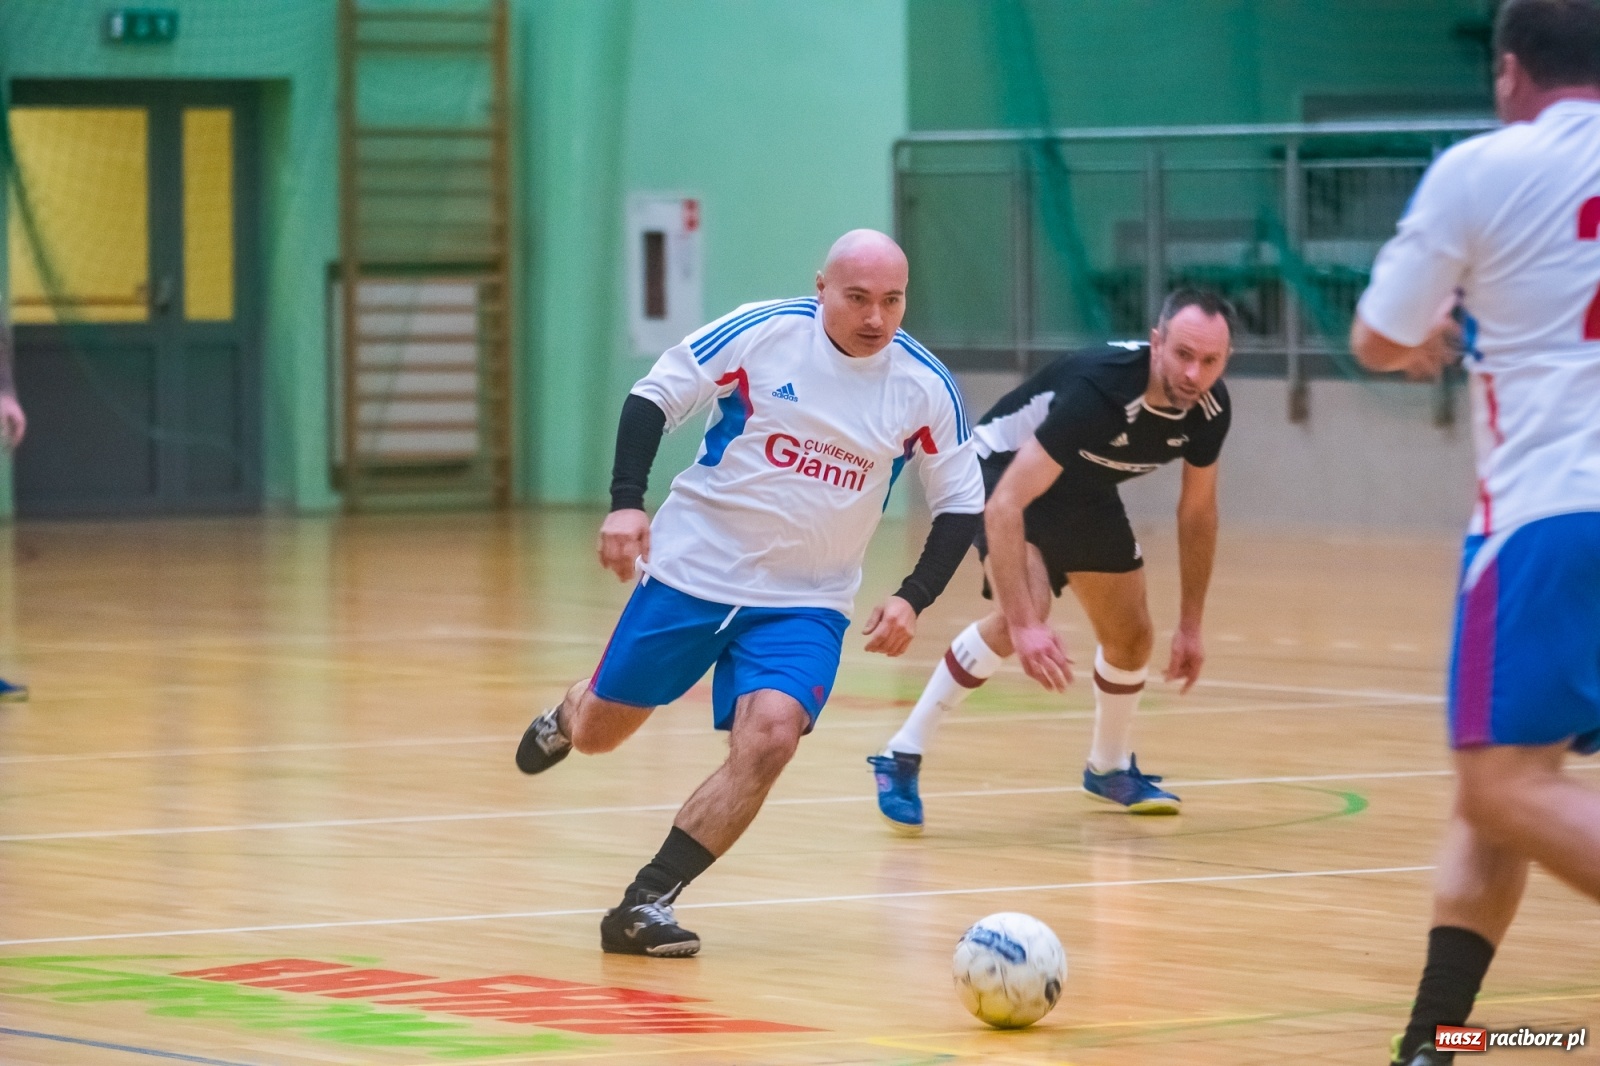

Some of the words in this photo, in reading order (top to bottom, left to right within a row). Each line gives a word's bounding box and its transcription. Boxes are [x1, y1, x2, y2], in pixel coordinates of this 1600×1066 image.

[772, 390, 798, 402] adidas
[765, 433, 866, 492] Gianni
[804, 439, 875, 470] CUKIERNIA
[168, 958, 836, 1035] RAFAKO
